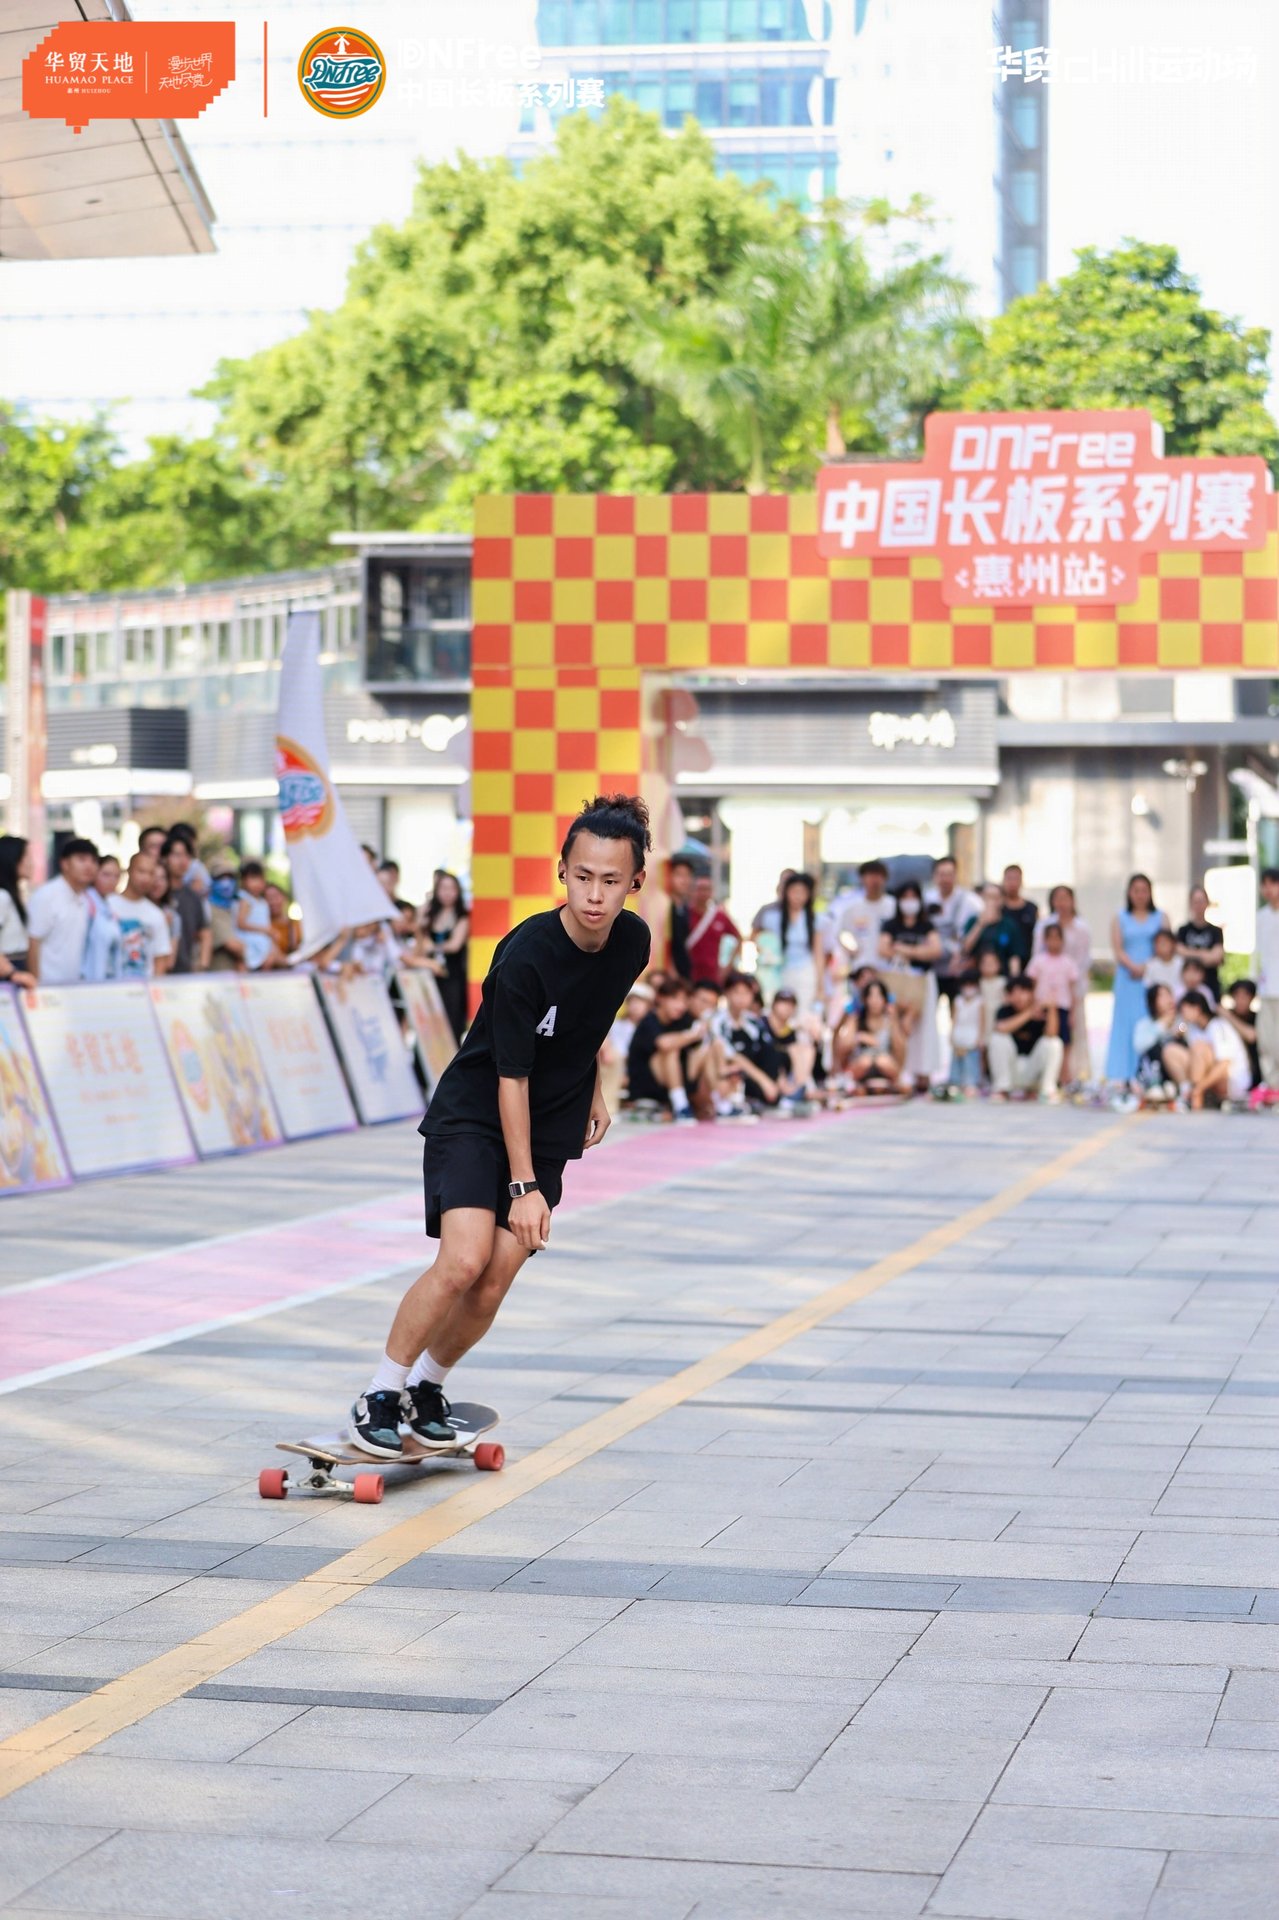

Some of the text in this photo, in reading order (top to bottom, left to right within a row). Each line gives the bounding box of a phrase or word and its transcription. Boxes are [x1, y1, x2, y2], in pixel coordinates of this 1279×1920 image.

[822, 470, 1256, 549] 中国长板系列赛
[535, 1005, 558, 1037] A
